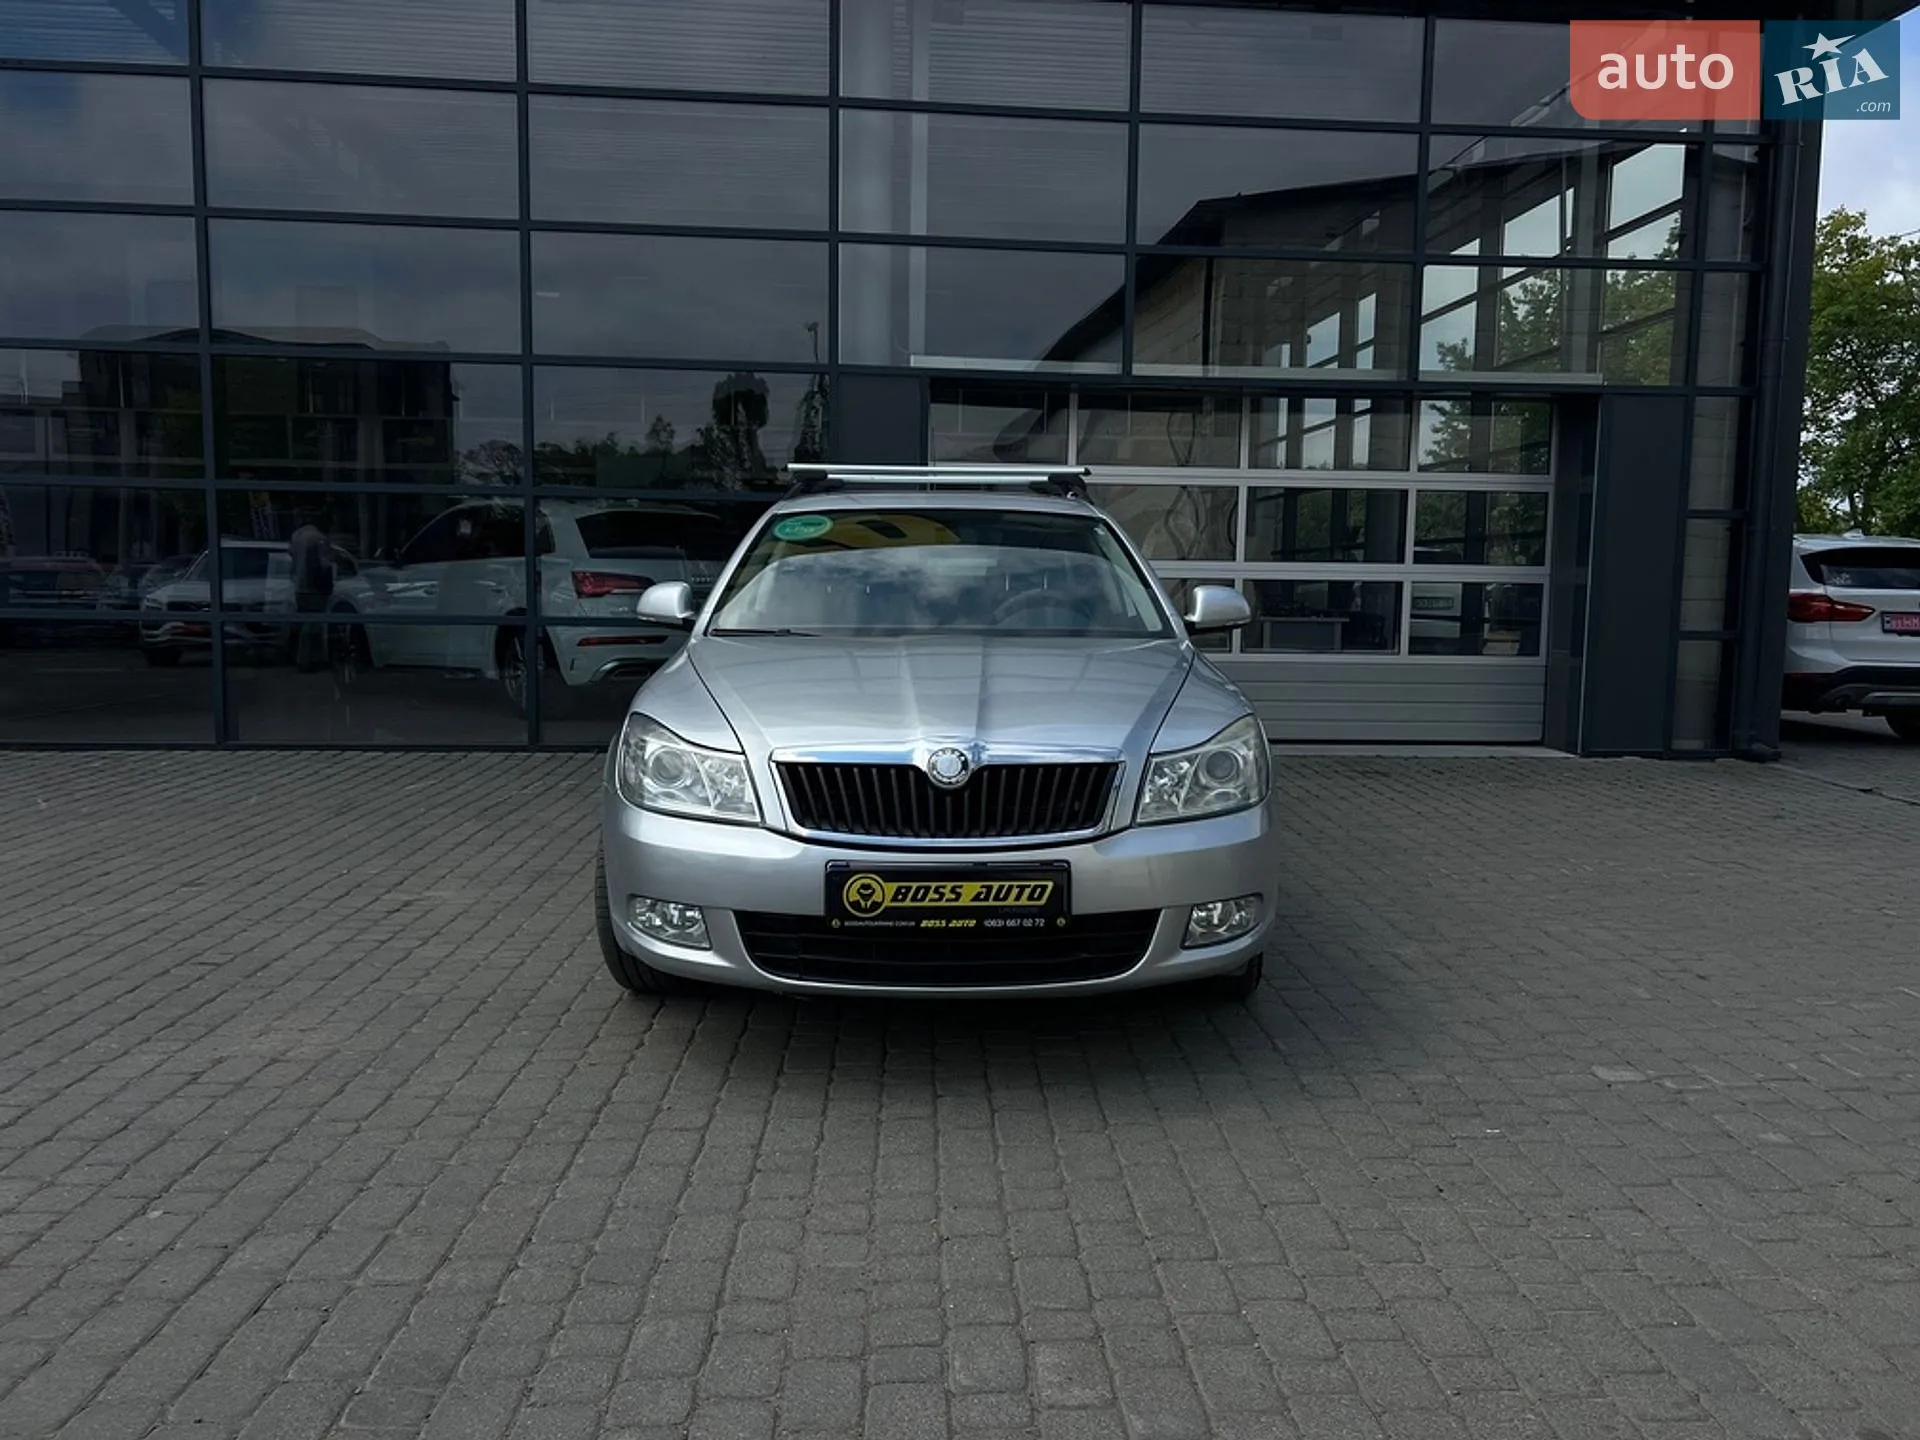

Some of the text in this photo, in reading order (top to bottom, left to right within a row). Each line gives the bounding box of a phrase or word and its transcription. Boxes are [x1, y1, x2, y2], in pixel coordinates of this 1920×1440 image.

[890, 884, 1050, 903] BOSS AUTO
[920, 919, 946, 928] BOSS
[1035, 918, 1045, 928] 72
